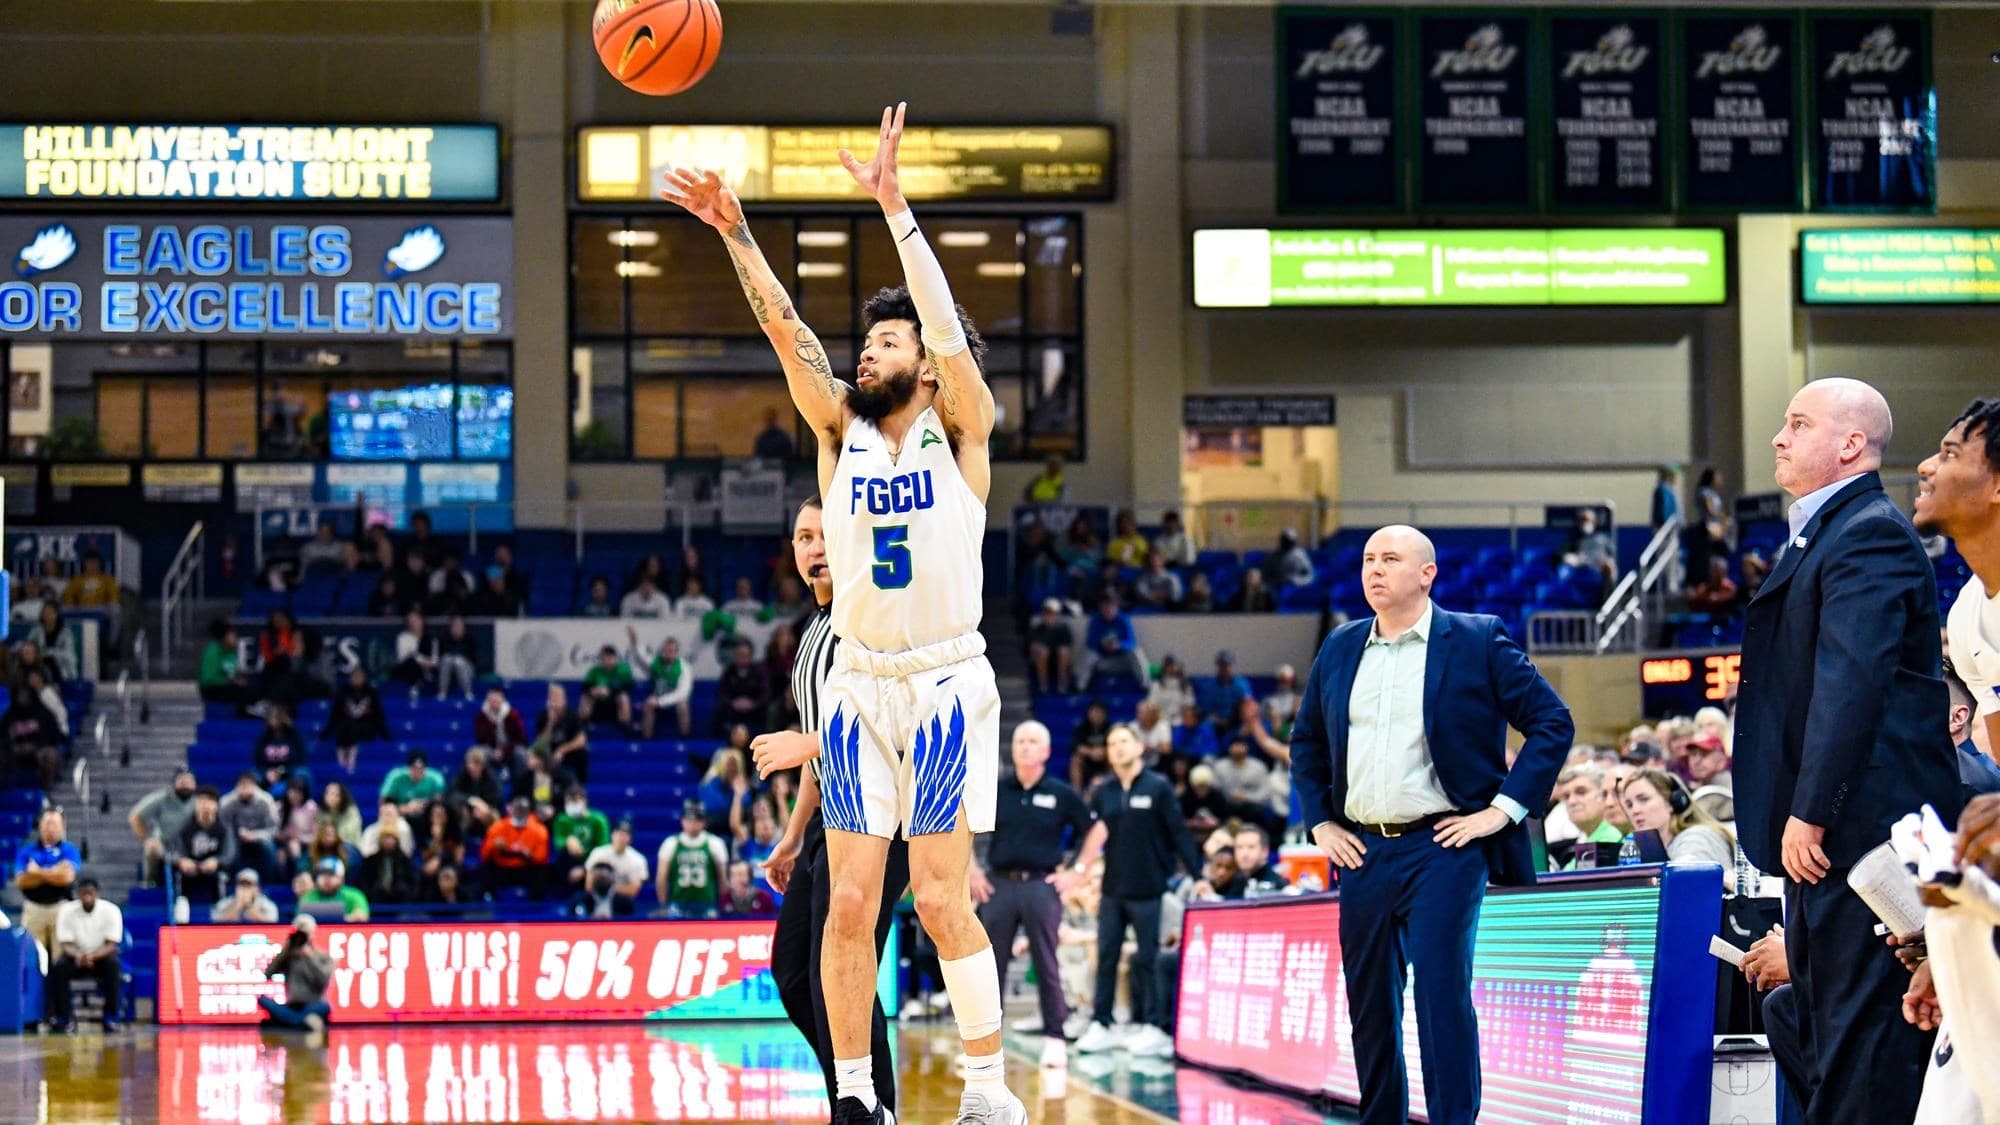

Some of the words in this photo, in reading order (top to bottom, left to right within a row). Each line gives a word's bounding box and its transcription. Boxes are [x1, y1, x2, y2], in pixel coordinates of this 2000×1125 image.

[1314, 96, 1366, 116] NCAA
[1449, 96, 1500, 116] NCAA
[1581, 97, 1633, 117] NCAA
[1714, 97, 1765, 117] NCAA
[1845, 97, 1895, 117] NCAA
[24, 127, 433, 162] HILLMYER-TREMONT
[1691, 117, 1789, 137] TOURNAMENT
[25, 161, 293, 197] FOUNDATION
[303, 161, 432, 198] SUITE
[103, 225, 352, 276] EAGLES
[101, 280, 502, 334] EXCELLENCE
[851, 470, 935, 515] FGCU
[872, 525, 913, 590] 5
[334, 967, 406, 1008] YOU
[428, 962, 520, 1007] WIN!
[535, 939, 636, 1000] 50%
[646, 939, 736, 1000] OFF
